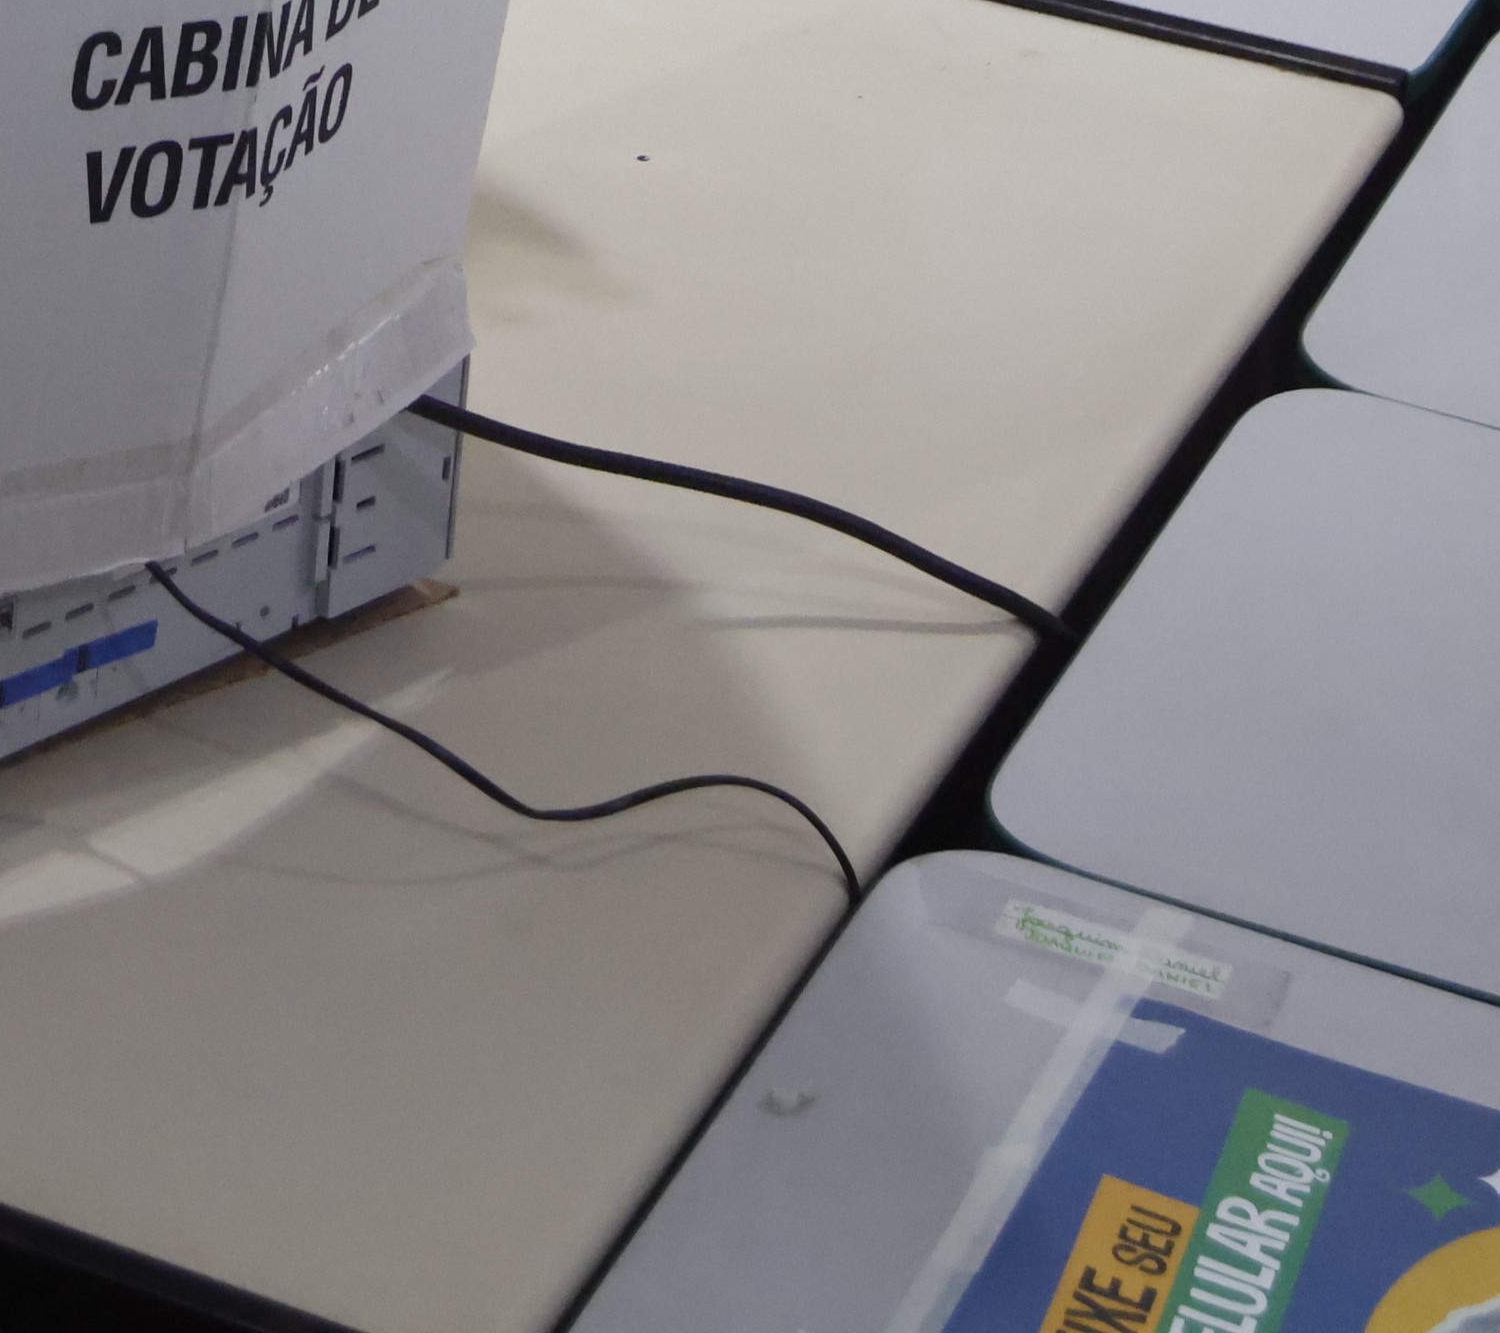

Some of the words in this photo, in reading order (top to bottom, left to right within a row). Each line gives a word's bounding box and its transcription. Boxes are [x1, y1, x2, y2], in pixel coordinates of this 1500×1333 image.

[86, 62, 353, 224] VOTAÇÃO
[1249, 1113, 1333, 1207] AQUI!
[1112, 1204, 1182, 1278] SEU
